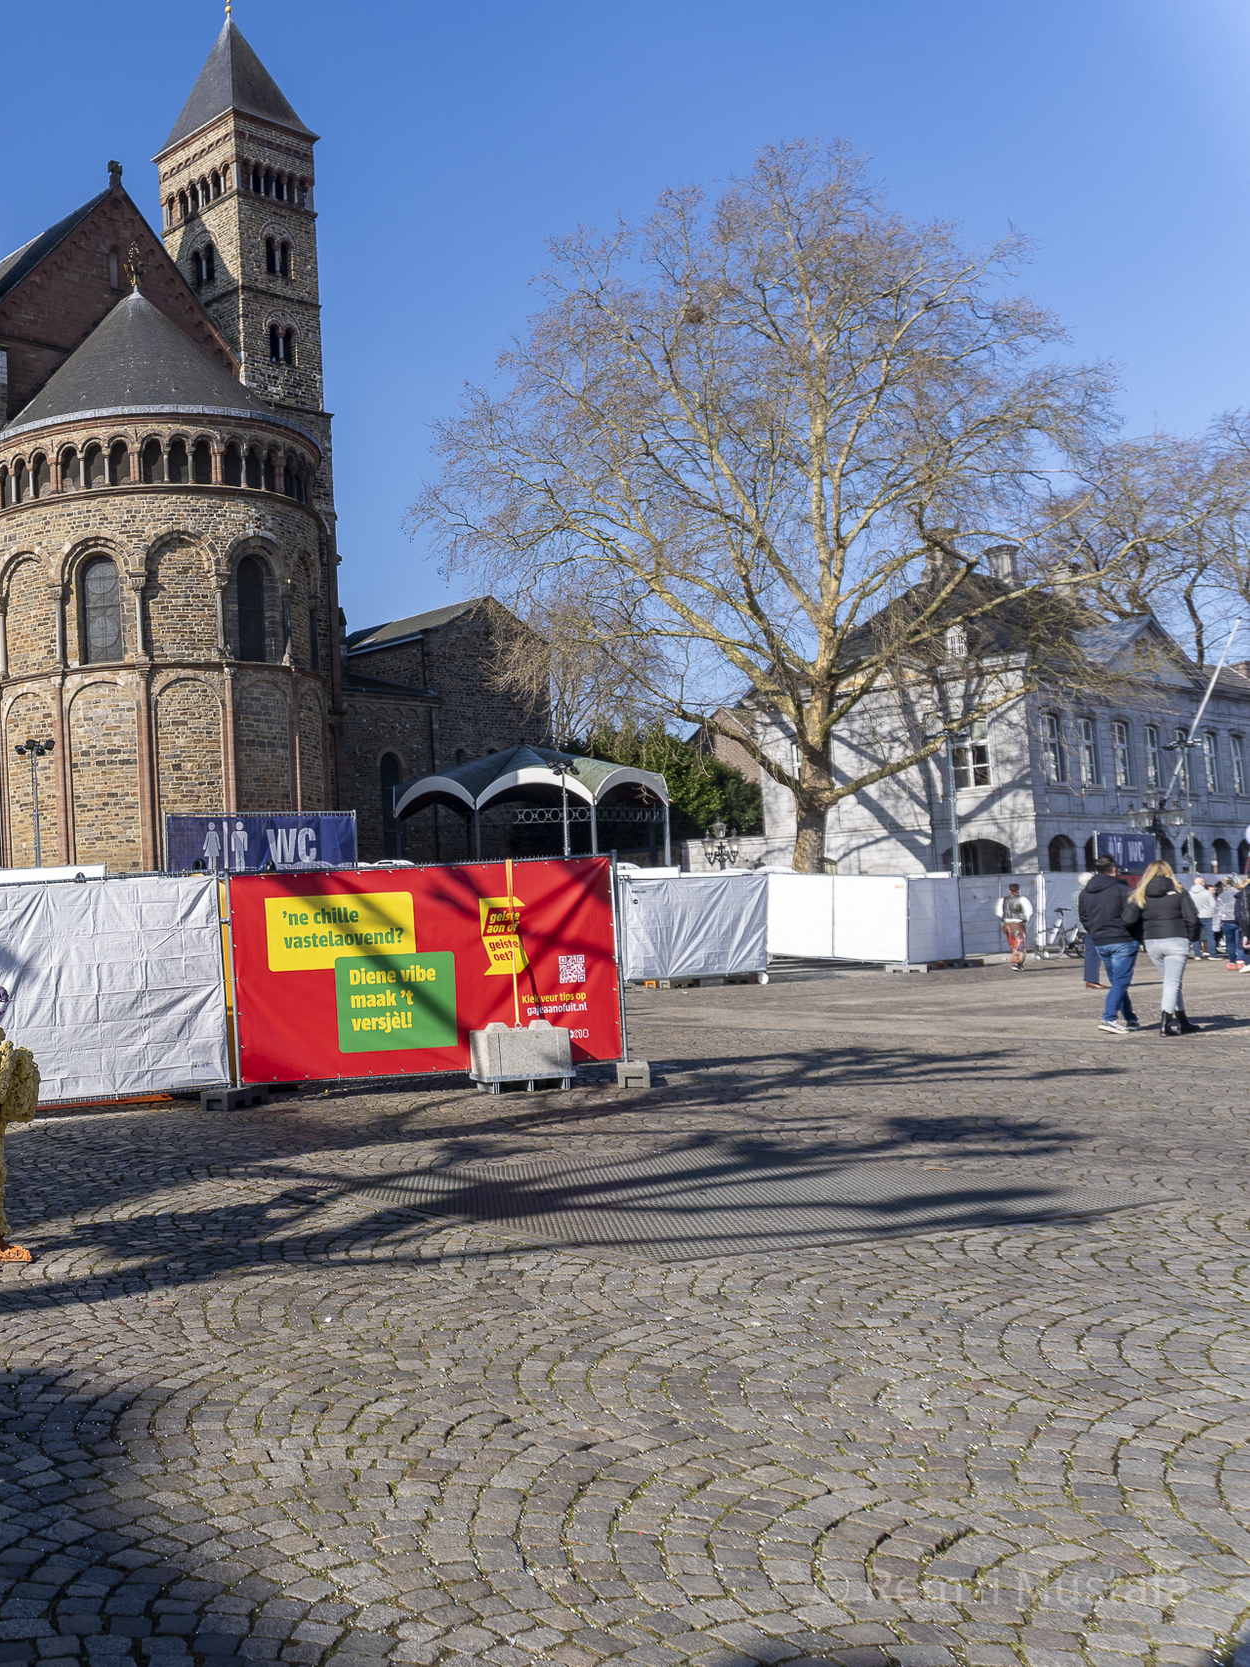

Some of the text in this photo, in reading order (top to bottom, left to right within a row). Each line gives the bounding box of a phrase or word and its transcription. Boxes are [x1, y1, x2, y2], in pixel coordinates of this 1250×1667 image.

[266, 827, 317, 863] WC
[1127, 841, 1145, 862] WC
[313, 907, 359, 924] chille
[486, 921, 520, 934] aon of
[283, 927, 404, 949] vastelaovend?
[489, 939, 519, 951] geiste
[493, 951, 513, 961] oet?
[349, 965, 436, 985] Diene vibe
[350, 989, 397, 1008] maak
[522, 992, 587, 1004] Kiek veur tips op
[527, 1002, 588, 1016] gajeaanofuit.nl
[351, 1011, 413, 1033] versjèl!
